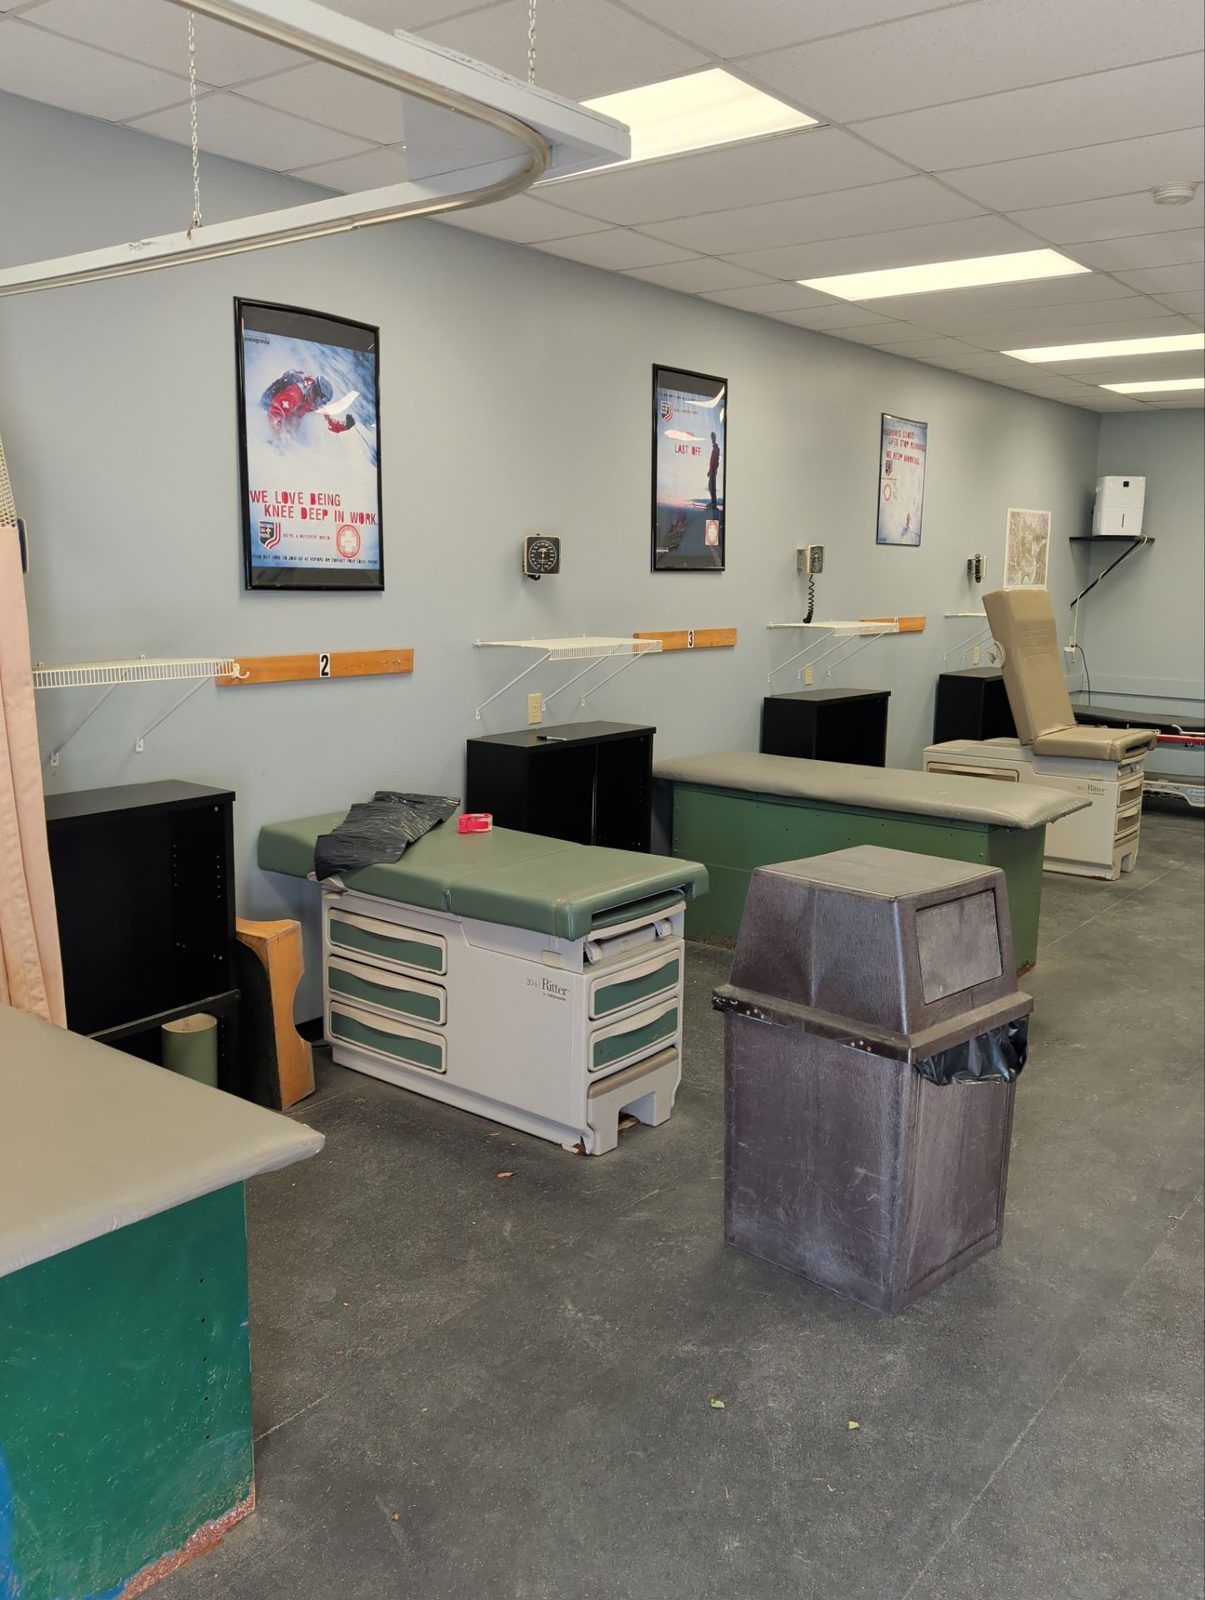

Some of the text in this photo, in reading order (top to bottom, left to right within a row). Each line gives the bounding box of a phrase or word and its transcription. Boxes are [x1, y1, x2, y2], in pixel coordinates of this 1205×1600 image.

[675, 443, 688, 455] LAST
[249, 489, 341, 507] WE LOVE BEING
[264, 503, 294, 518] KNEE
[300, 507, 328, 520] DEEP
[334, 509, 345, 522] IN
[689, 631, 693, 646] 3
[321, 655, 329, 676] 2
[542, 977, 567, 996] Ritter
